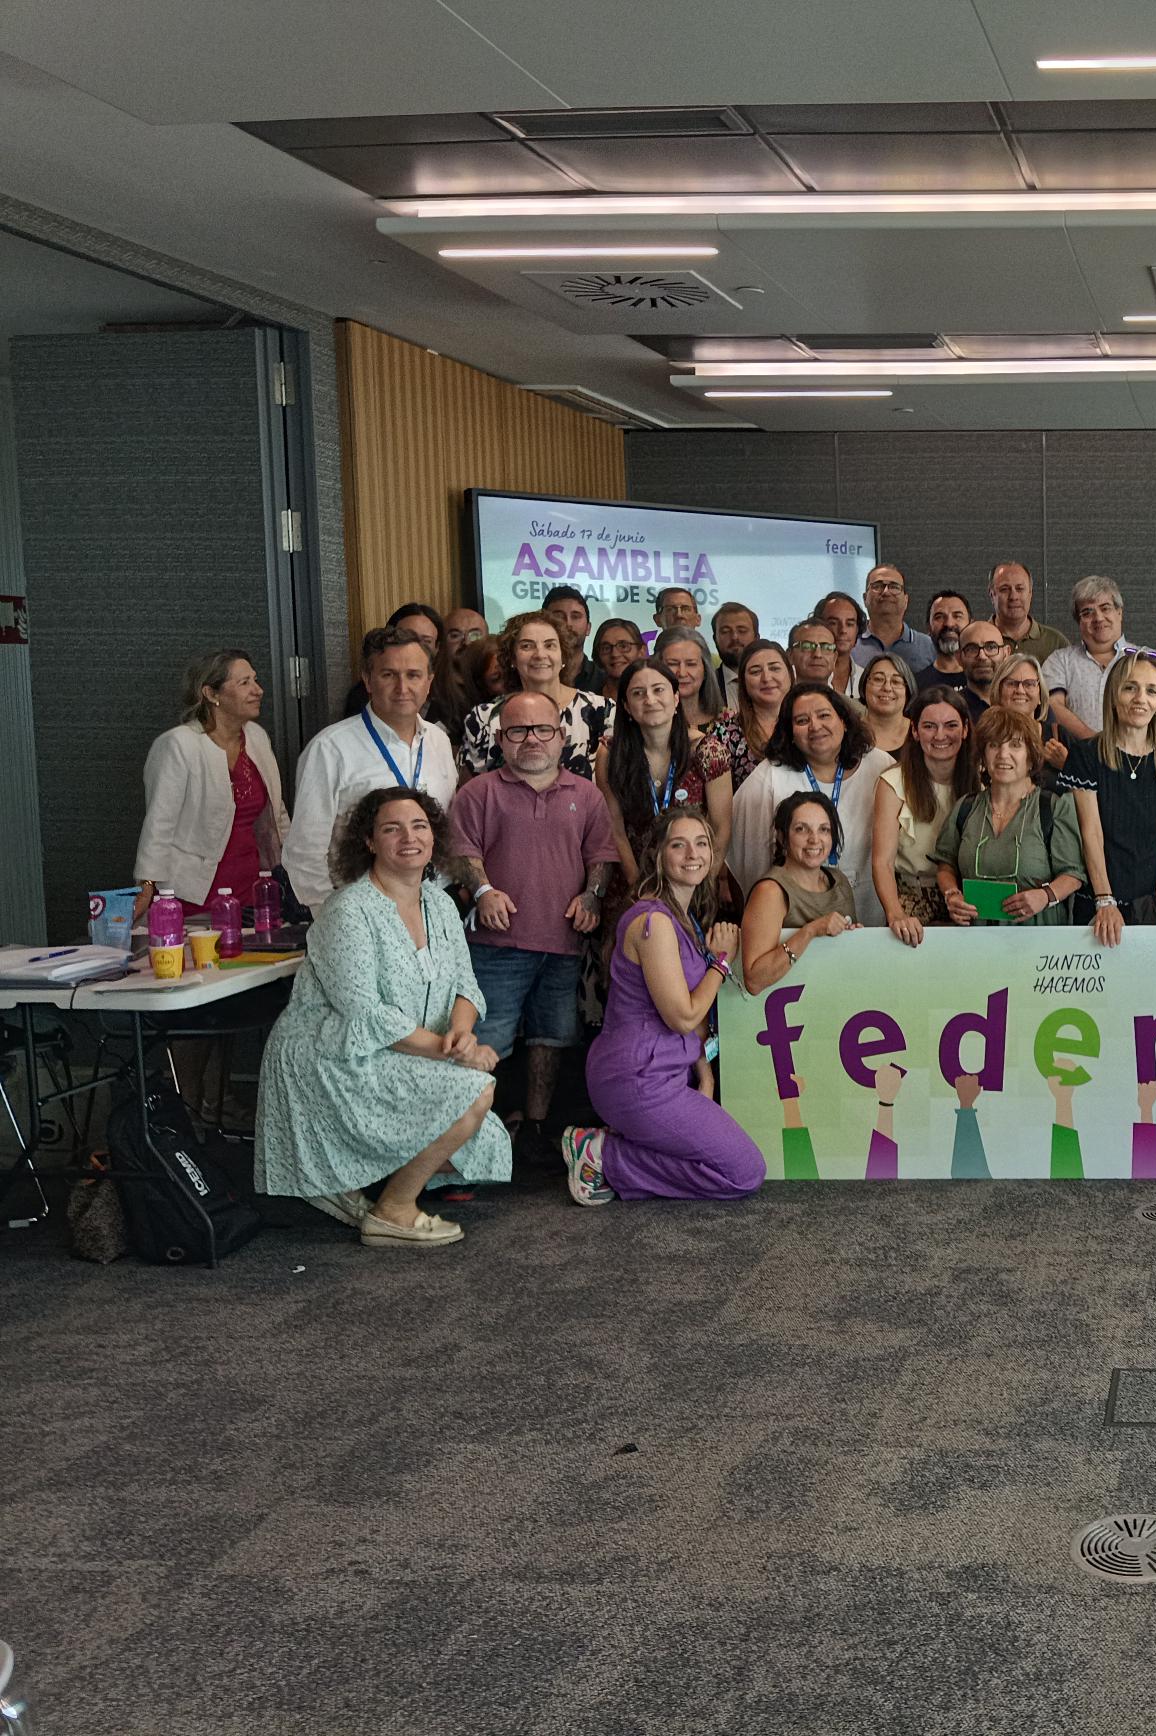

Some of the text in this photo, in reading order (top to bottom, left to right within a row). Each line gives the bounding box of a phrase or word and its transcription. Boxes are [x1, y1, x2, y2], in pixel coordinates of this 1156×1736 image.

[529, 520, 646, 550] Sábado 17 de junio
[825, 538, 863, 556] feder
[512, 542, 718, 585] ASAMBLEA
[511, 580, 720, 606] GENAL DE SOS
[1036, 953, 1102, 972] JUNTOS
[1033, 975, 1106, 995] HACEMOS
